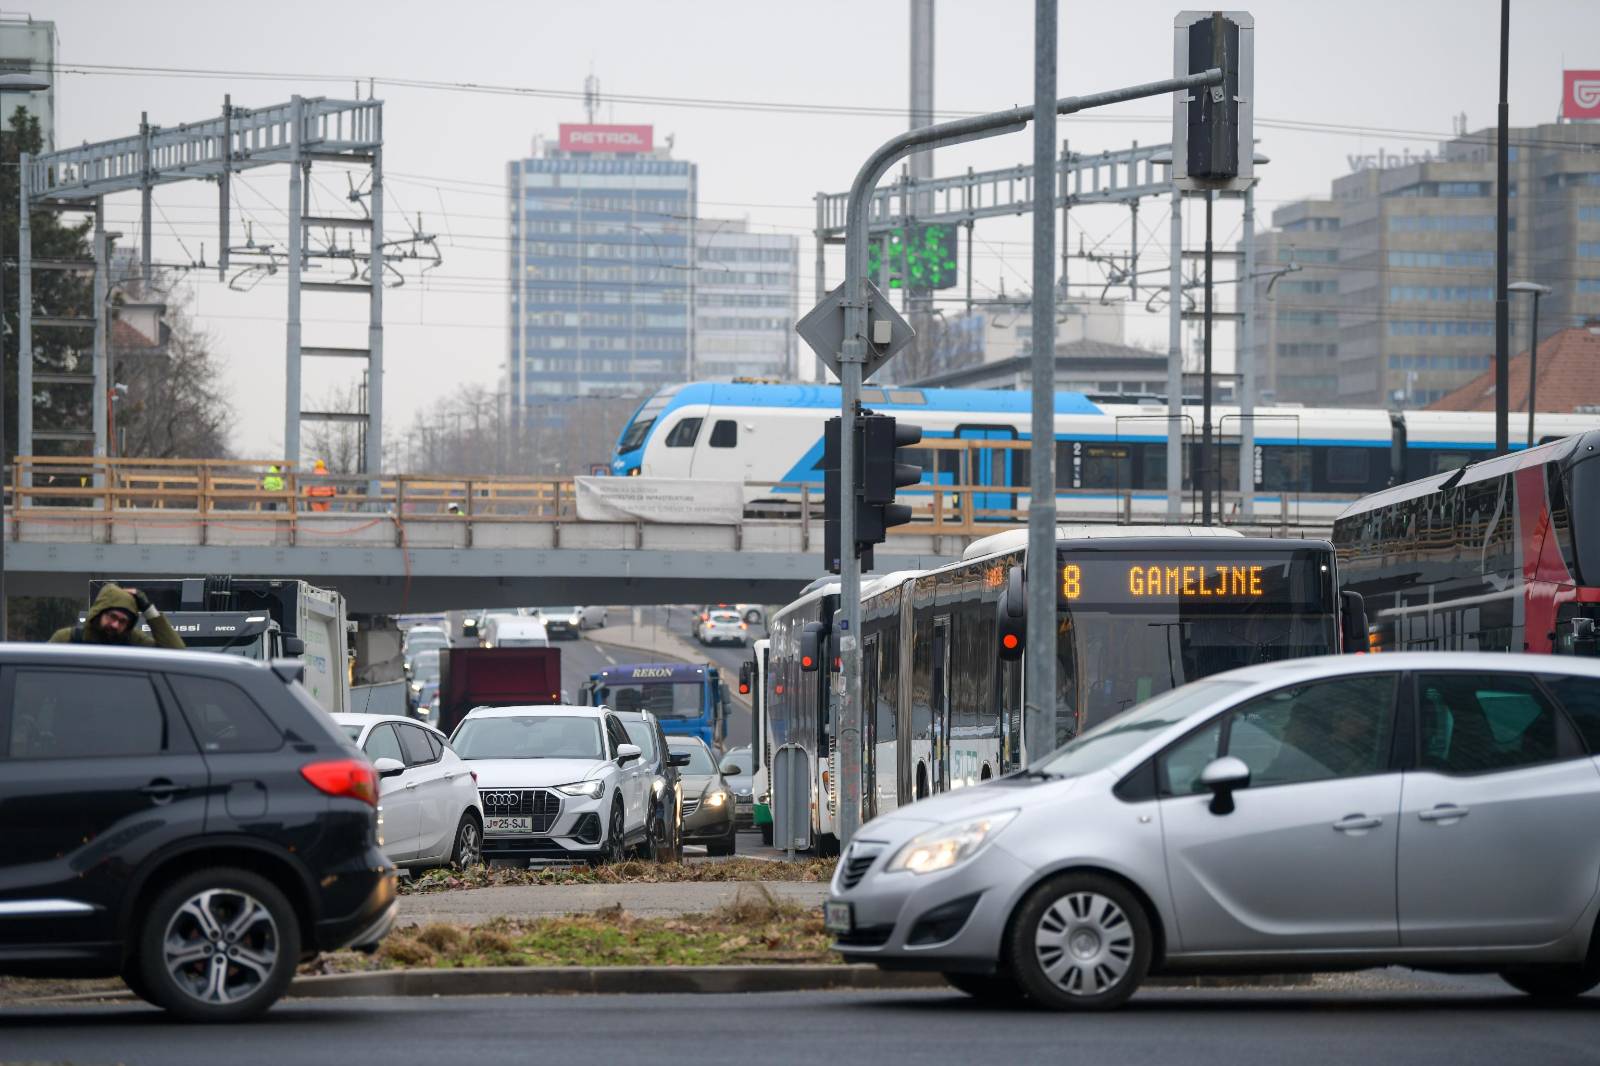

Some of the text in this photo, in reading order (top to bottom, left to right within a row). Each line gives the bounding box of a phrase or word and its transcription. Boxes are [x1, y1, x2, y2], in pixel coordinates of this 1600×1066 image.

[572, 131, 642, 144] PETROL
[1063, 564, 1263, 599] 8 GAMELJNE
[632, 668, 673, 678] REKON
[498, 818, 529, 829] 25-SJL
